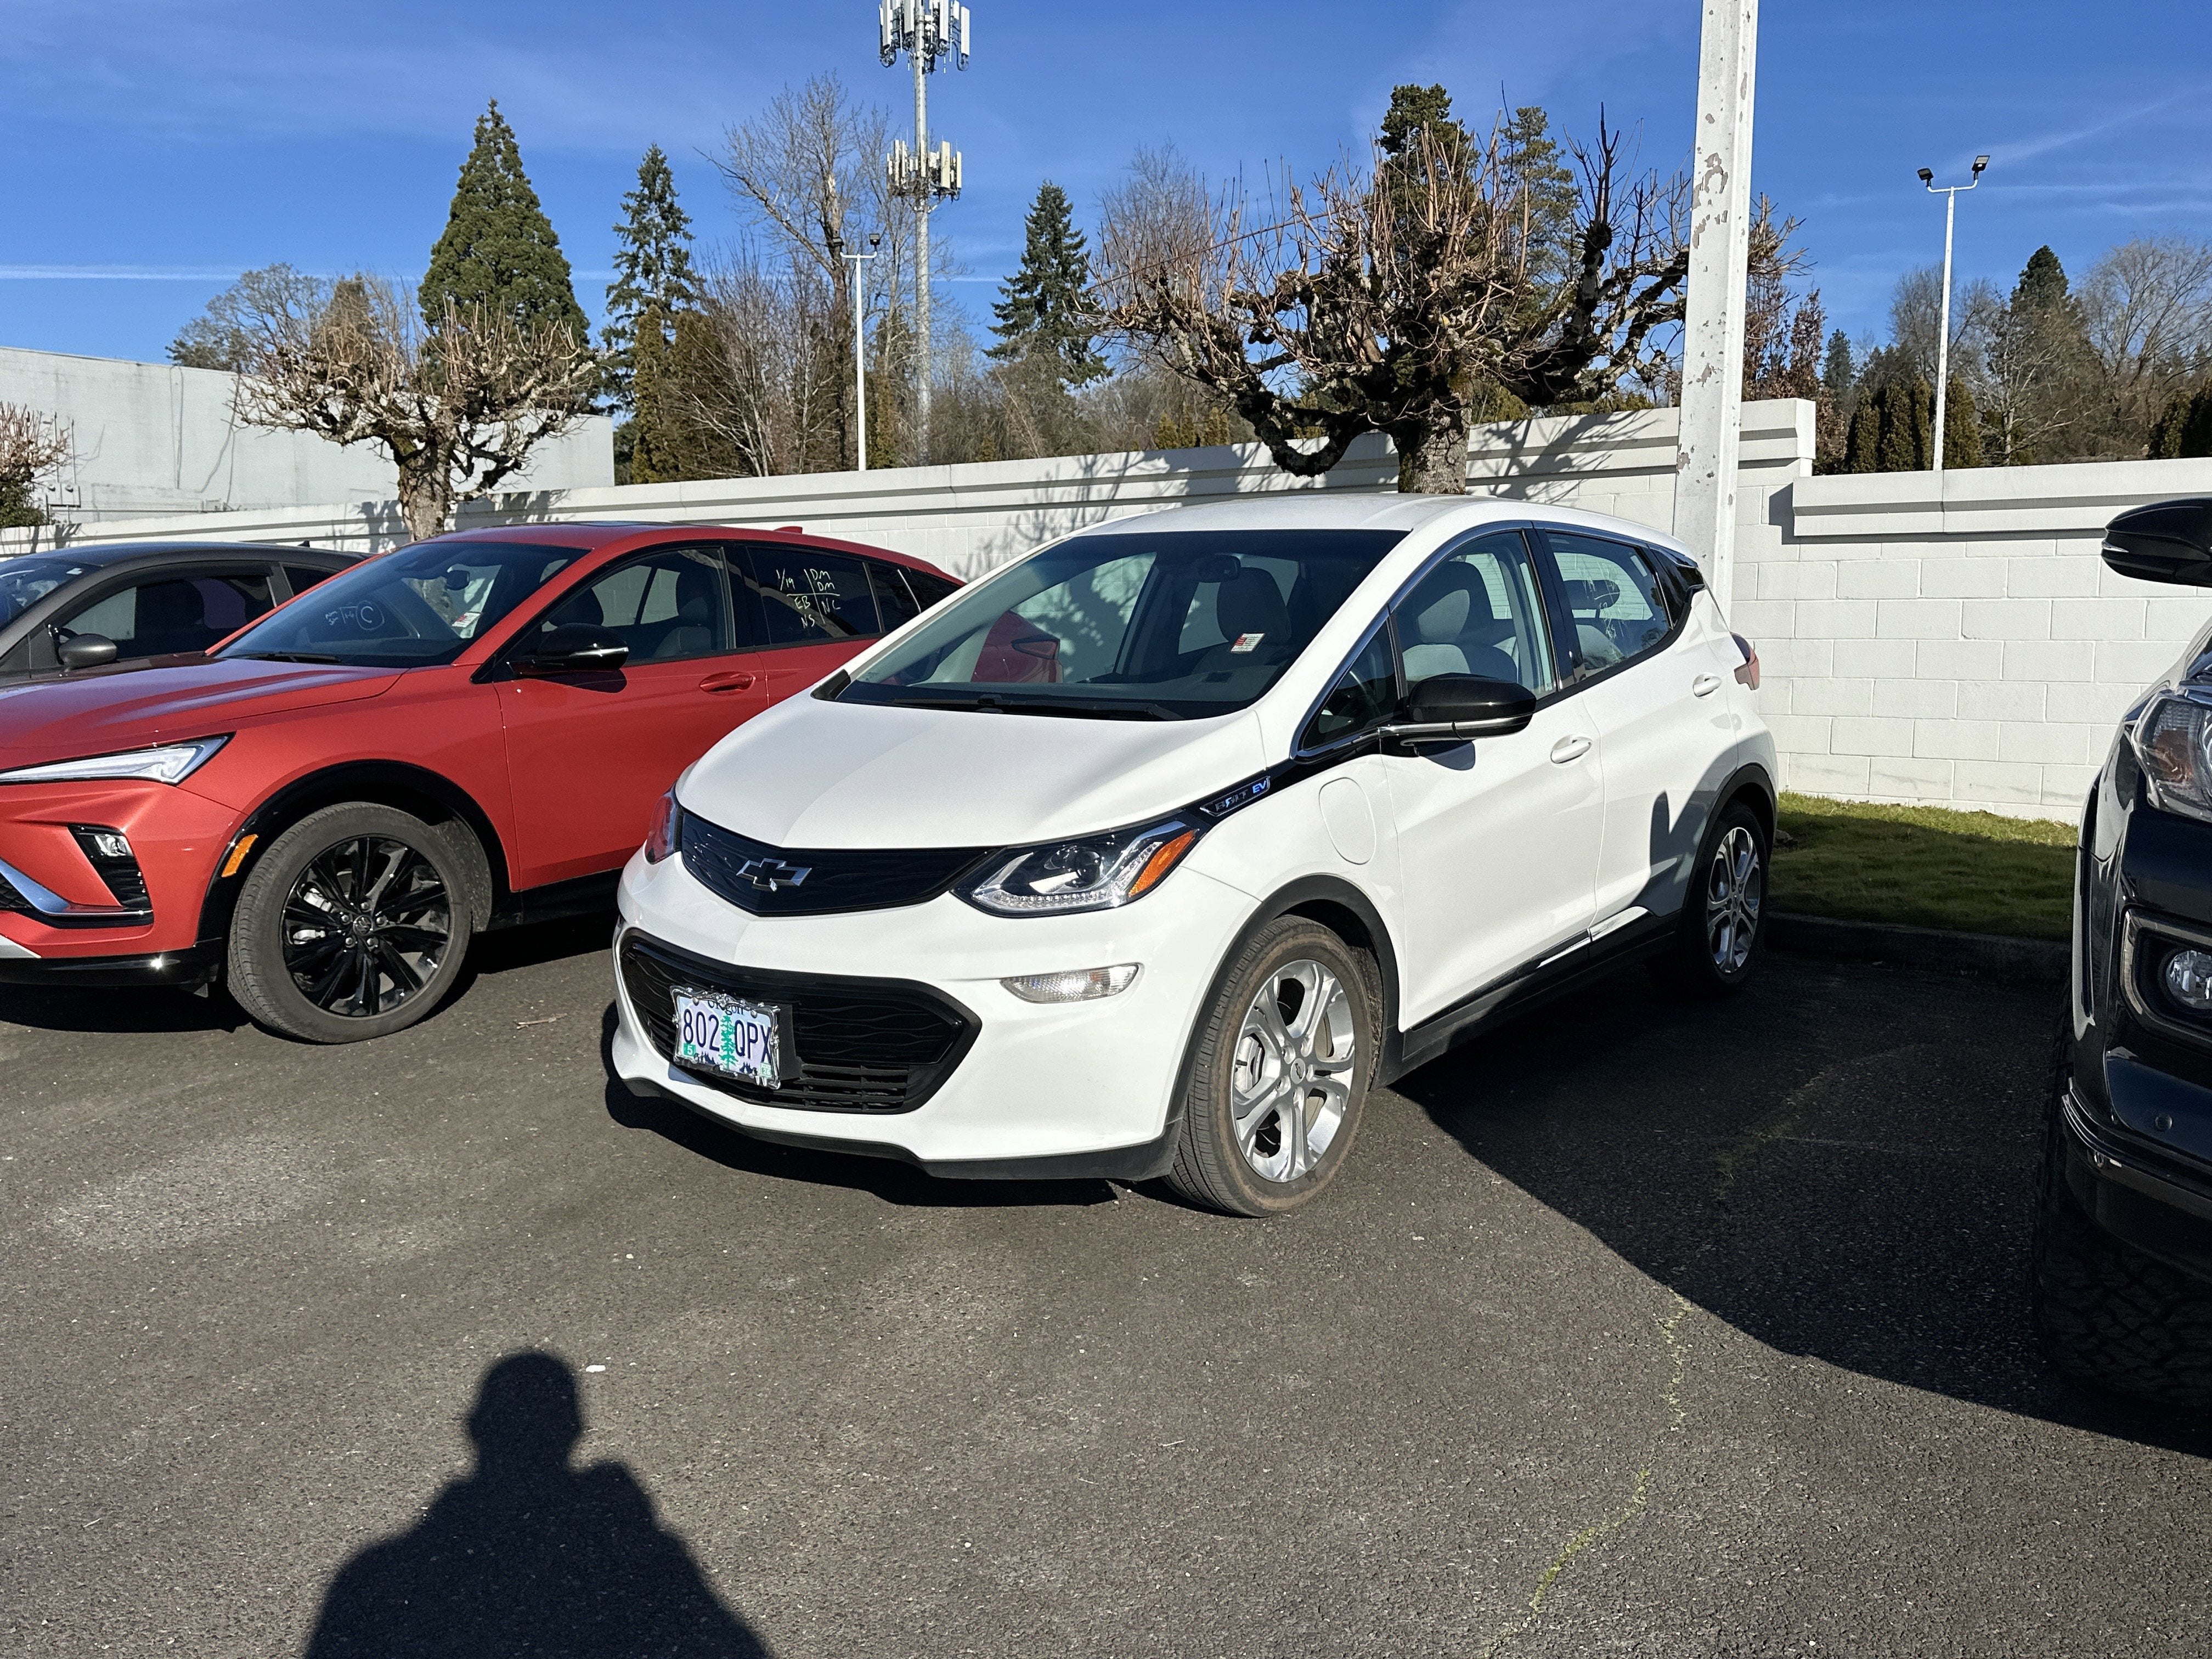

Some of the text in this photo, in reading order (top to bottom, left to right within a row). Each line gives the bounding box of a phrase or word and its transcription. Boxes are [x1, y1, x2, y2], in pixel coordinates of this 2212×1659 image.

[1252, 780, 1267, 794] EV
[683, 1008, 771, 1064] 802 QPX
[686, 1045, 694, 1055] 5
